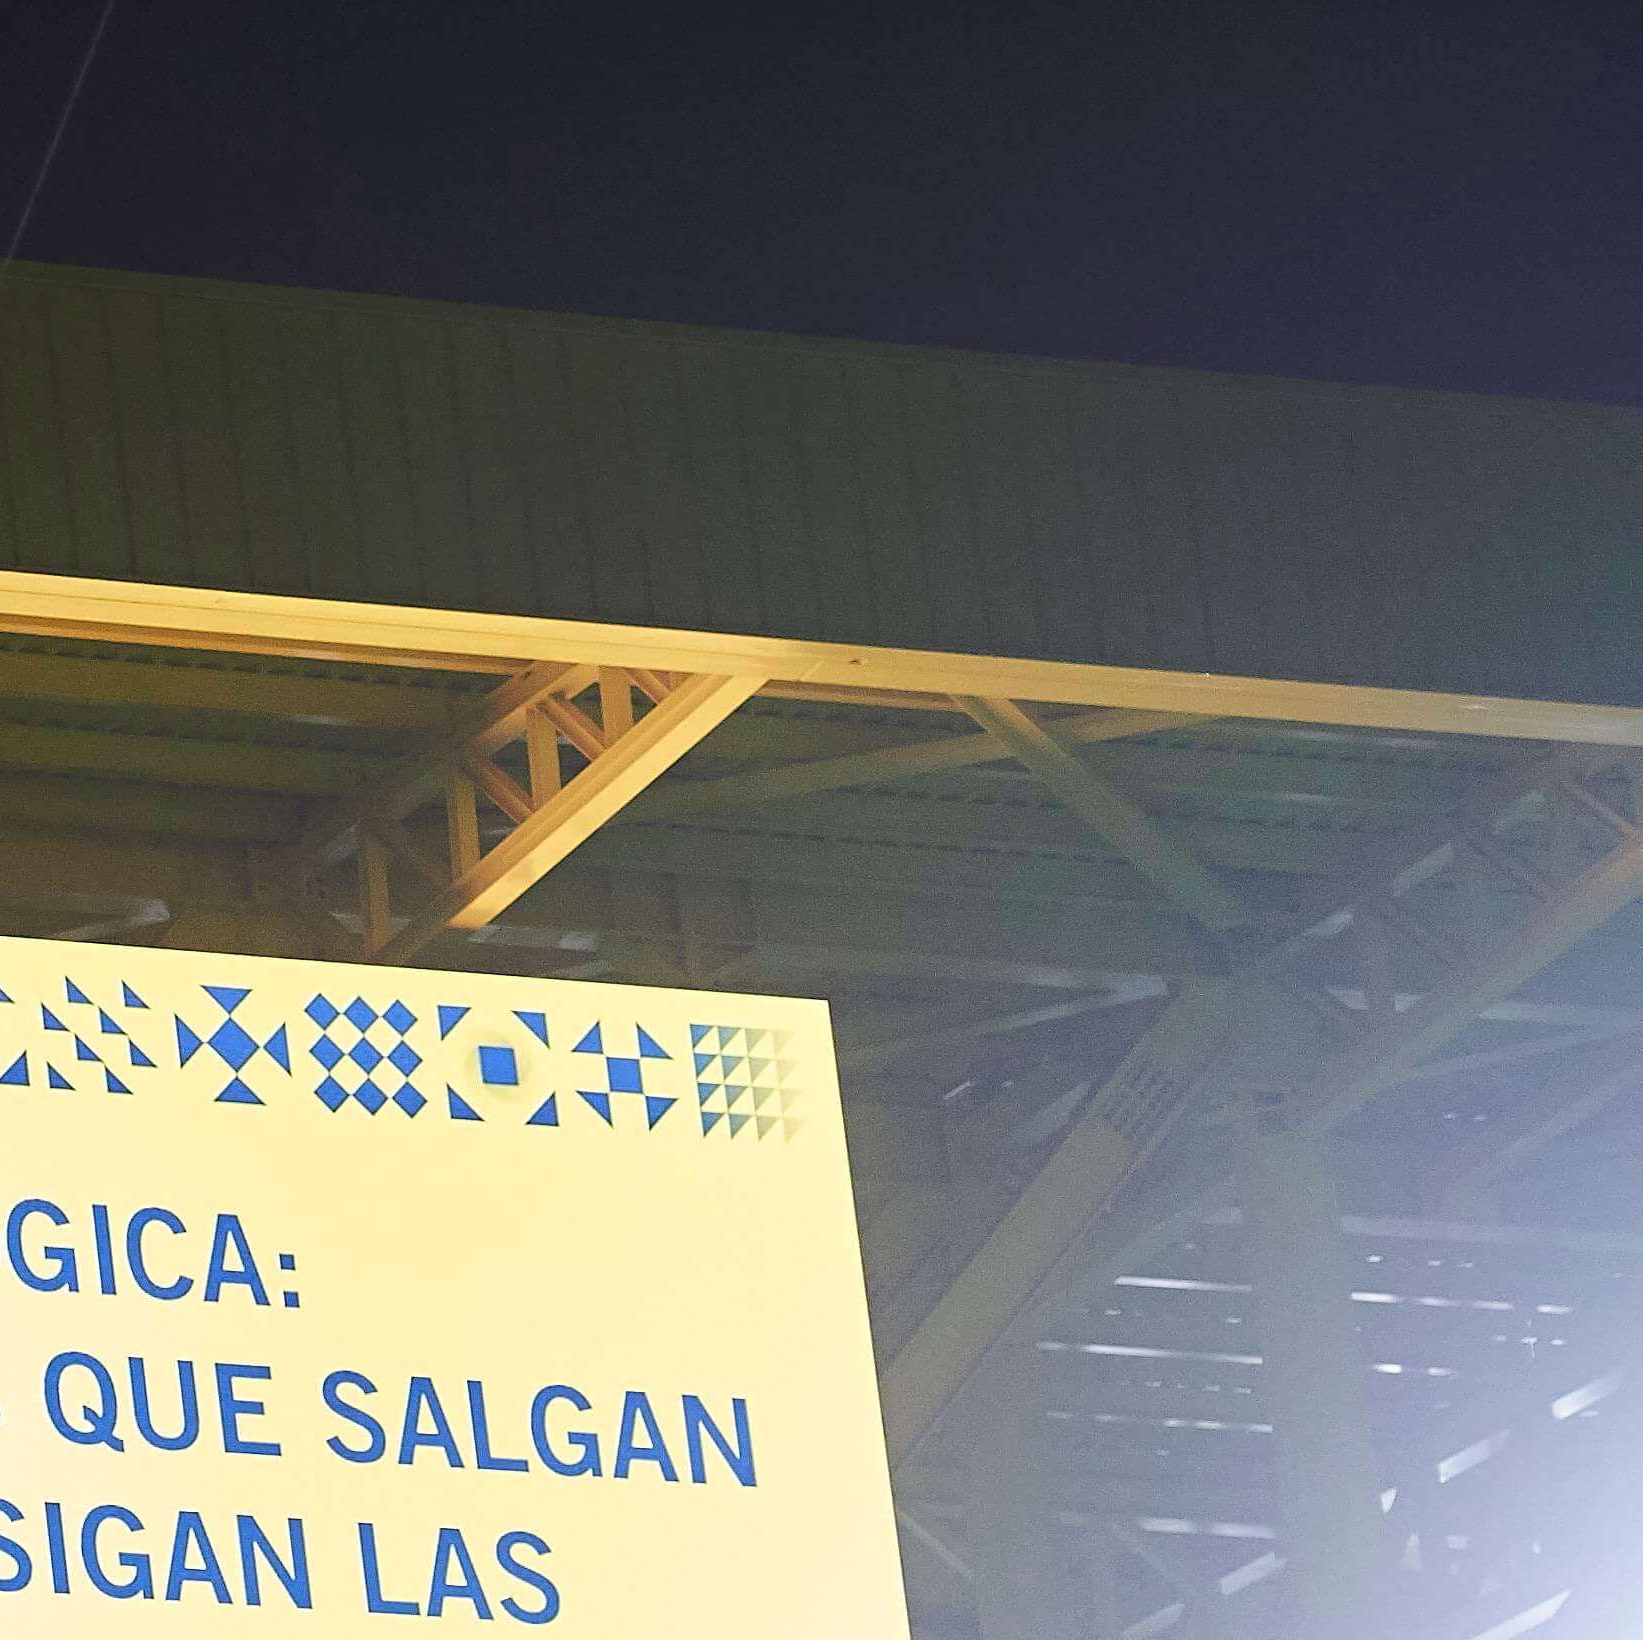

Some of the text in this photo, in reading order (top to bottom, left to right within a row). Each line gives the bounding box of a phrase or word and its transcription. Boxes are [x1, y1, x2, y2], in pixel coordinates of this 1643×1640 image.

[43, 1351, 282, 1457] QUE
[322, 1369, 757, 1487] SALGAN
[357, 1522, 560, 1625] LAS
